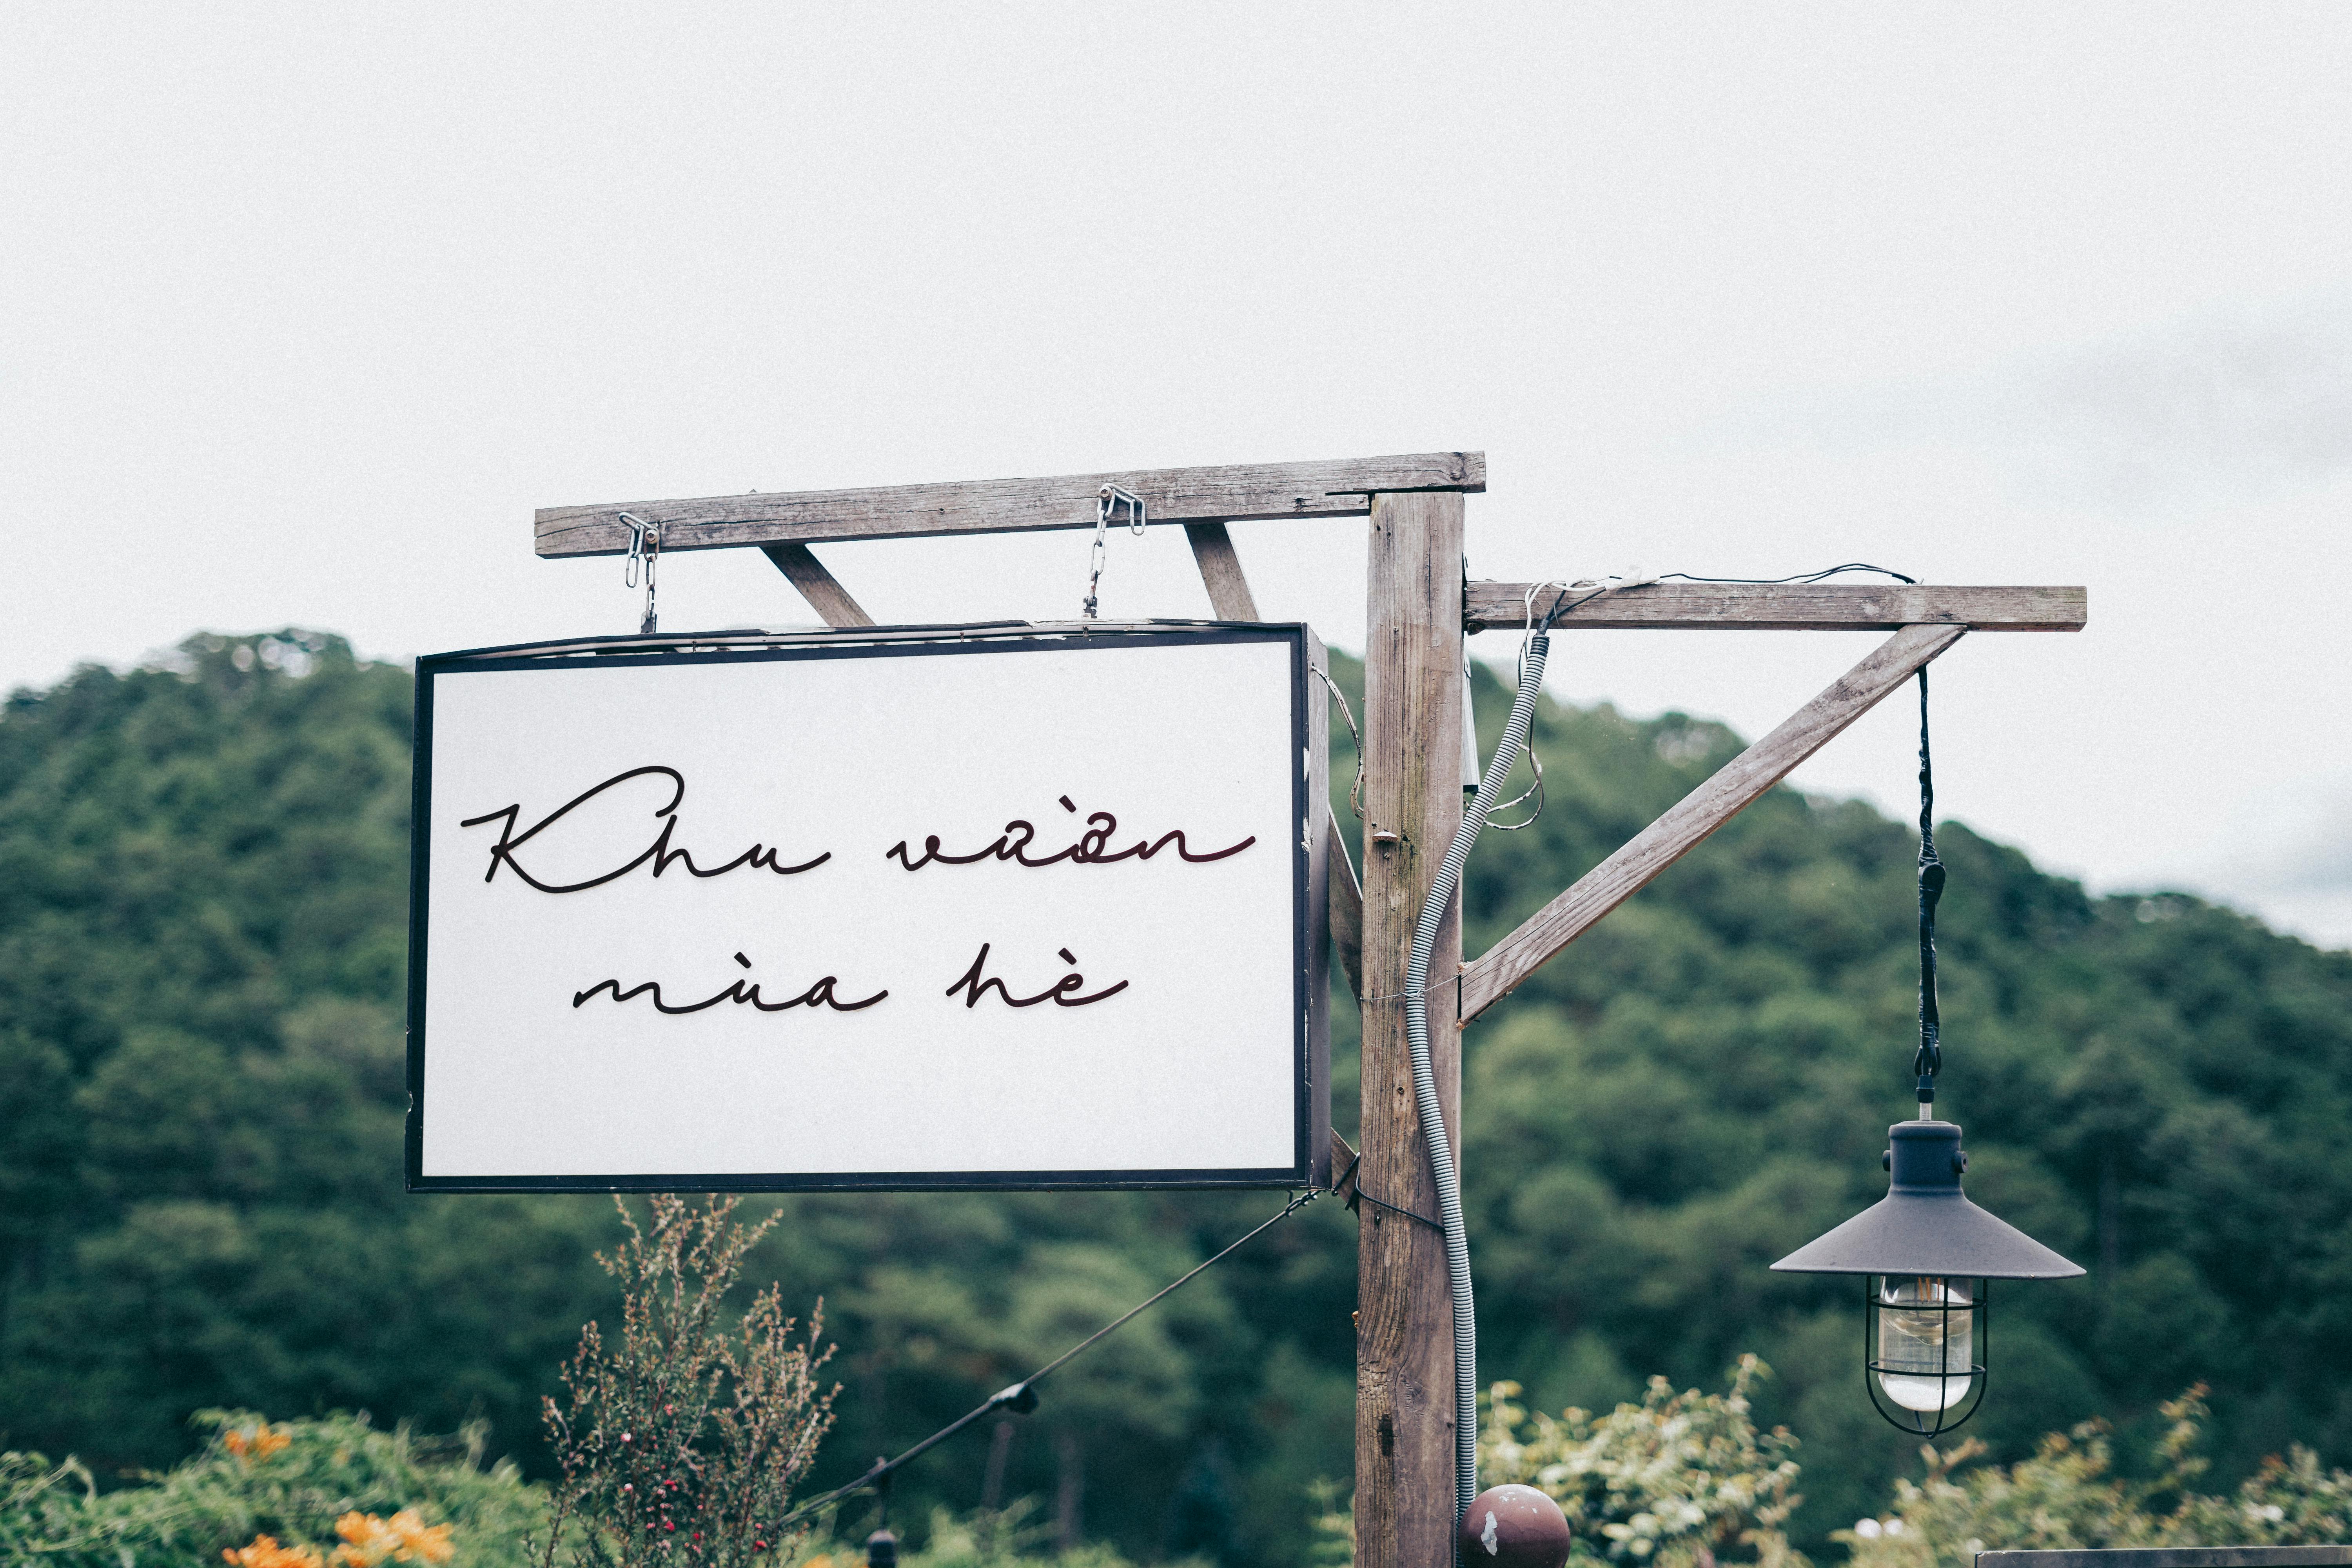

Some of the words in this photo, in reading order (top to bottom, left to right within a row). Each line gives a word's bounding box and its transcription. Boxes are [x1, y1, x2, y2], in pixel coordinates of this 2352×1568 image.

[461, 766, 831, 893] Khu
[573, 952, 888, 1014] mùa
[946, 943, 1128, 1008] hè
